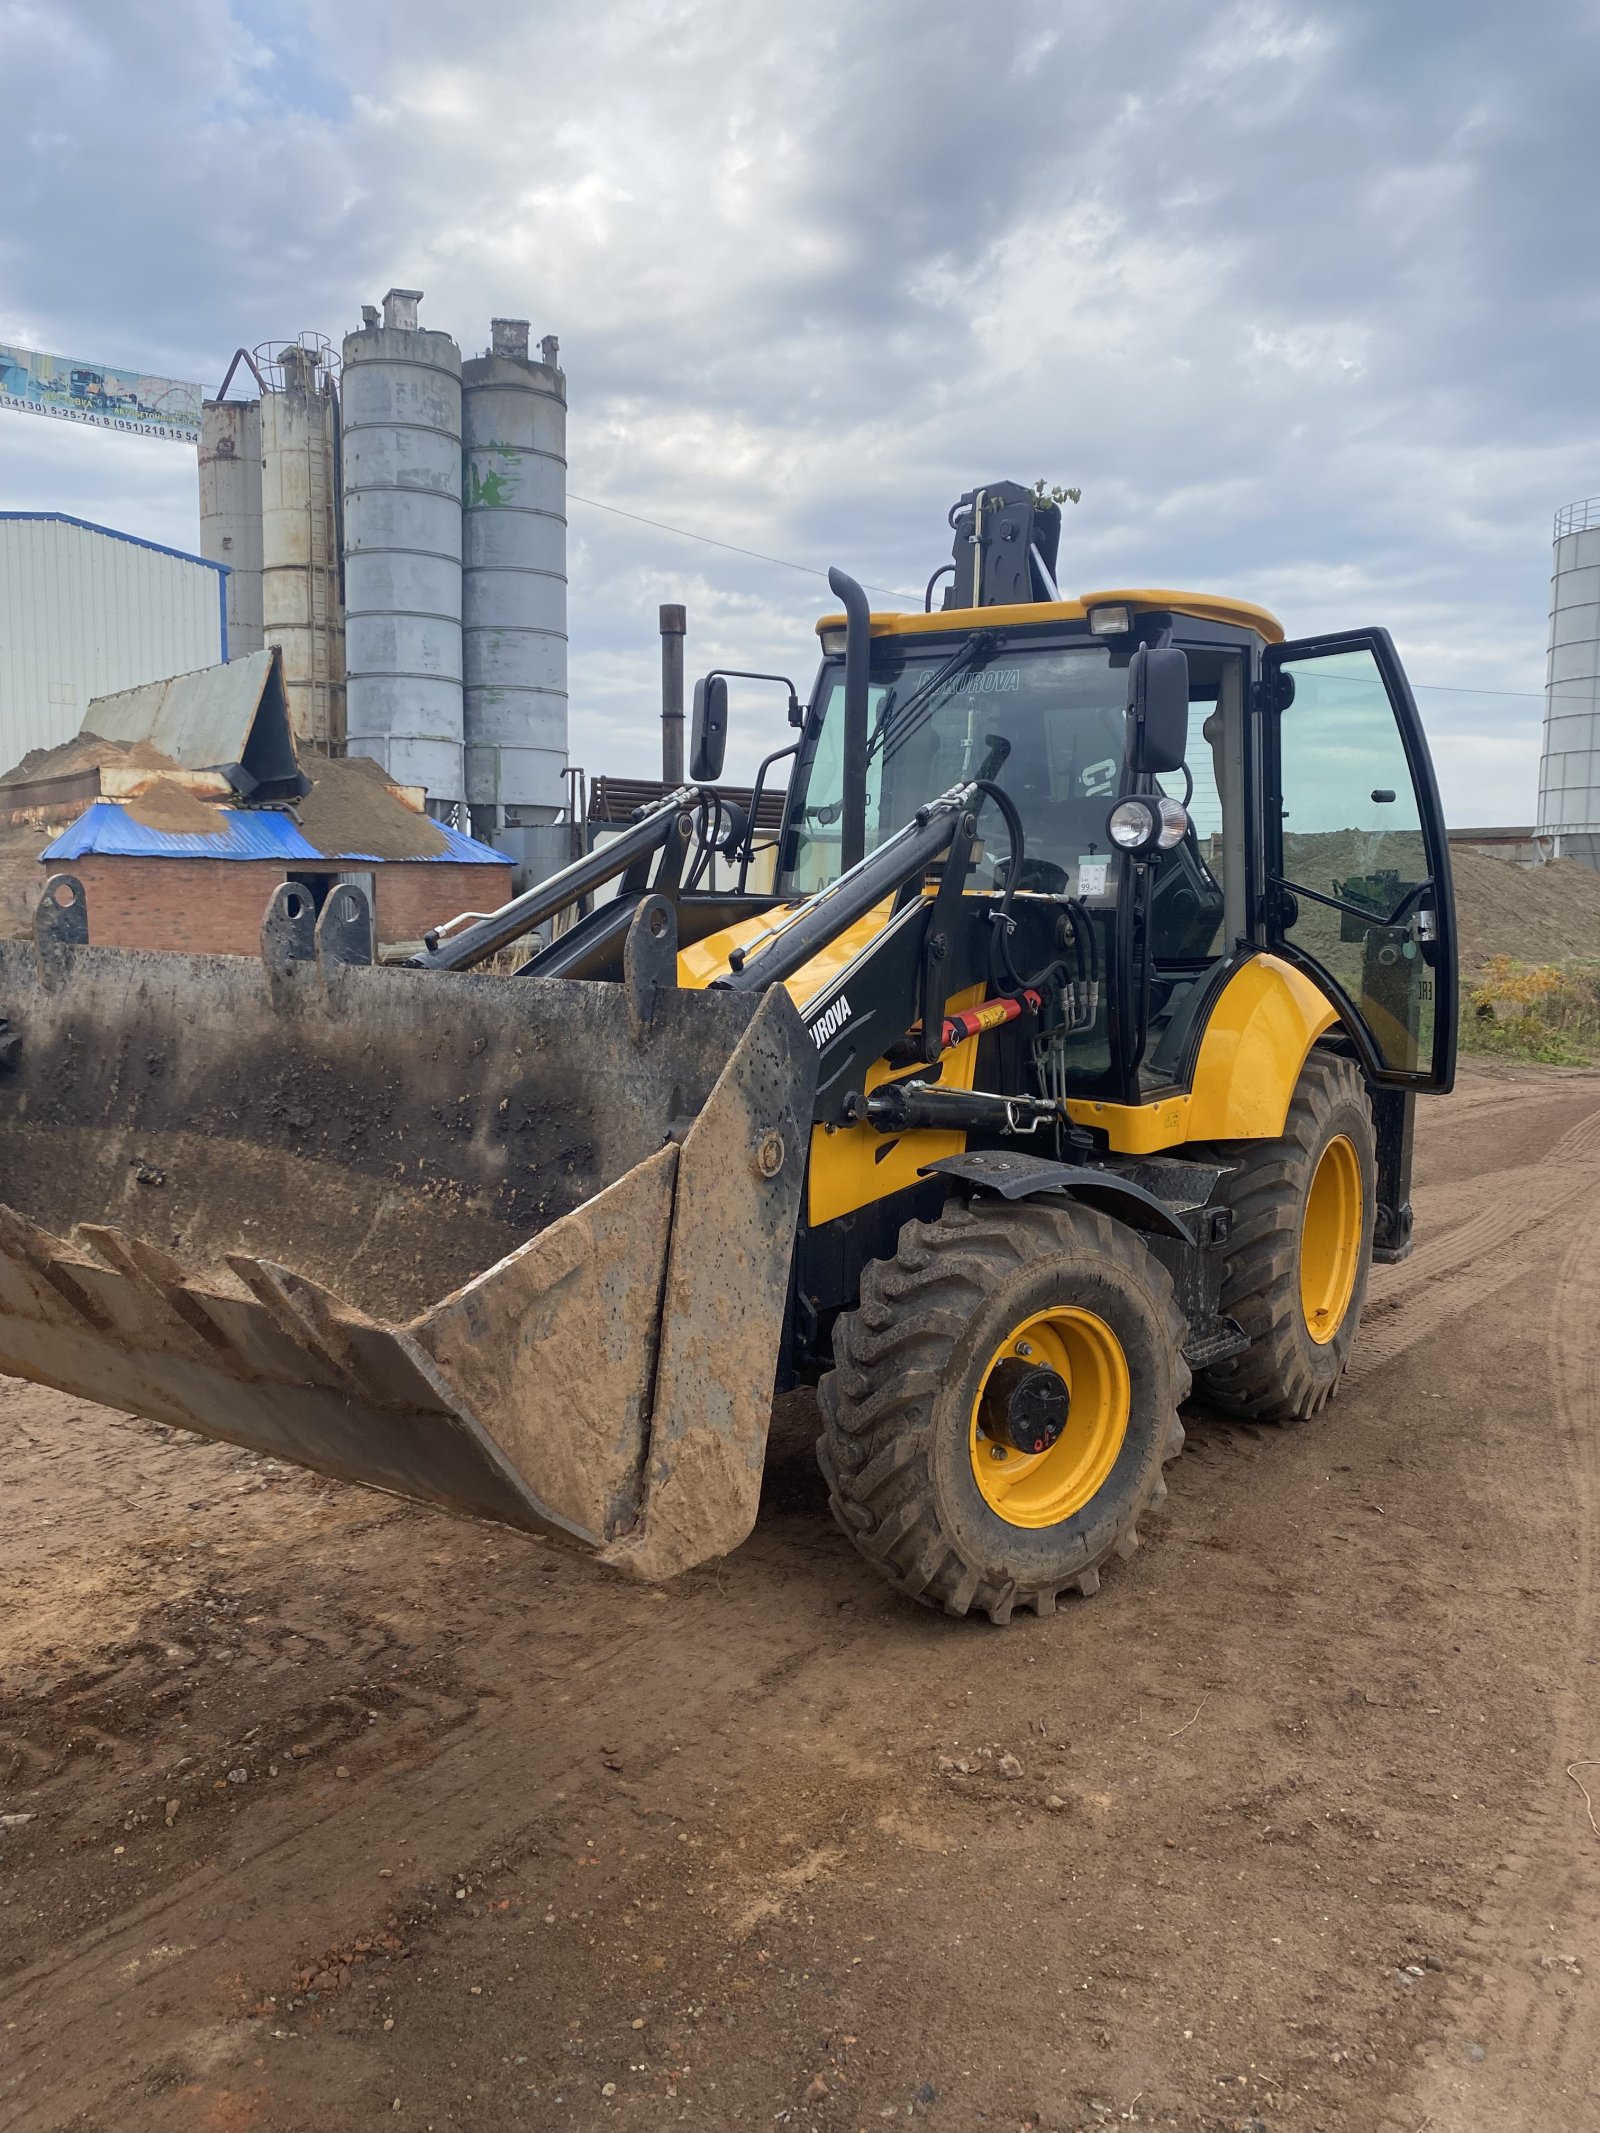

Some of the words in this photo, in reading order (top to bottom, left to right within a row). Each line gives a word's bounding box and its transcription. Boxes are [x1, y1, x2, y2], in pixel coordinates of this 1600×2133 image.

[103, 417, 110, 426] 8
[169, 429, 182, 439] 15
[186, 432, 198, 442] 54
